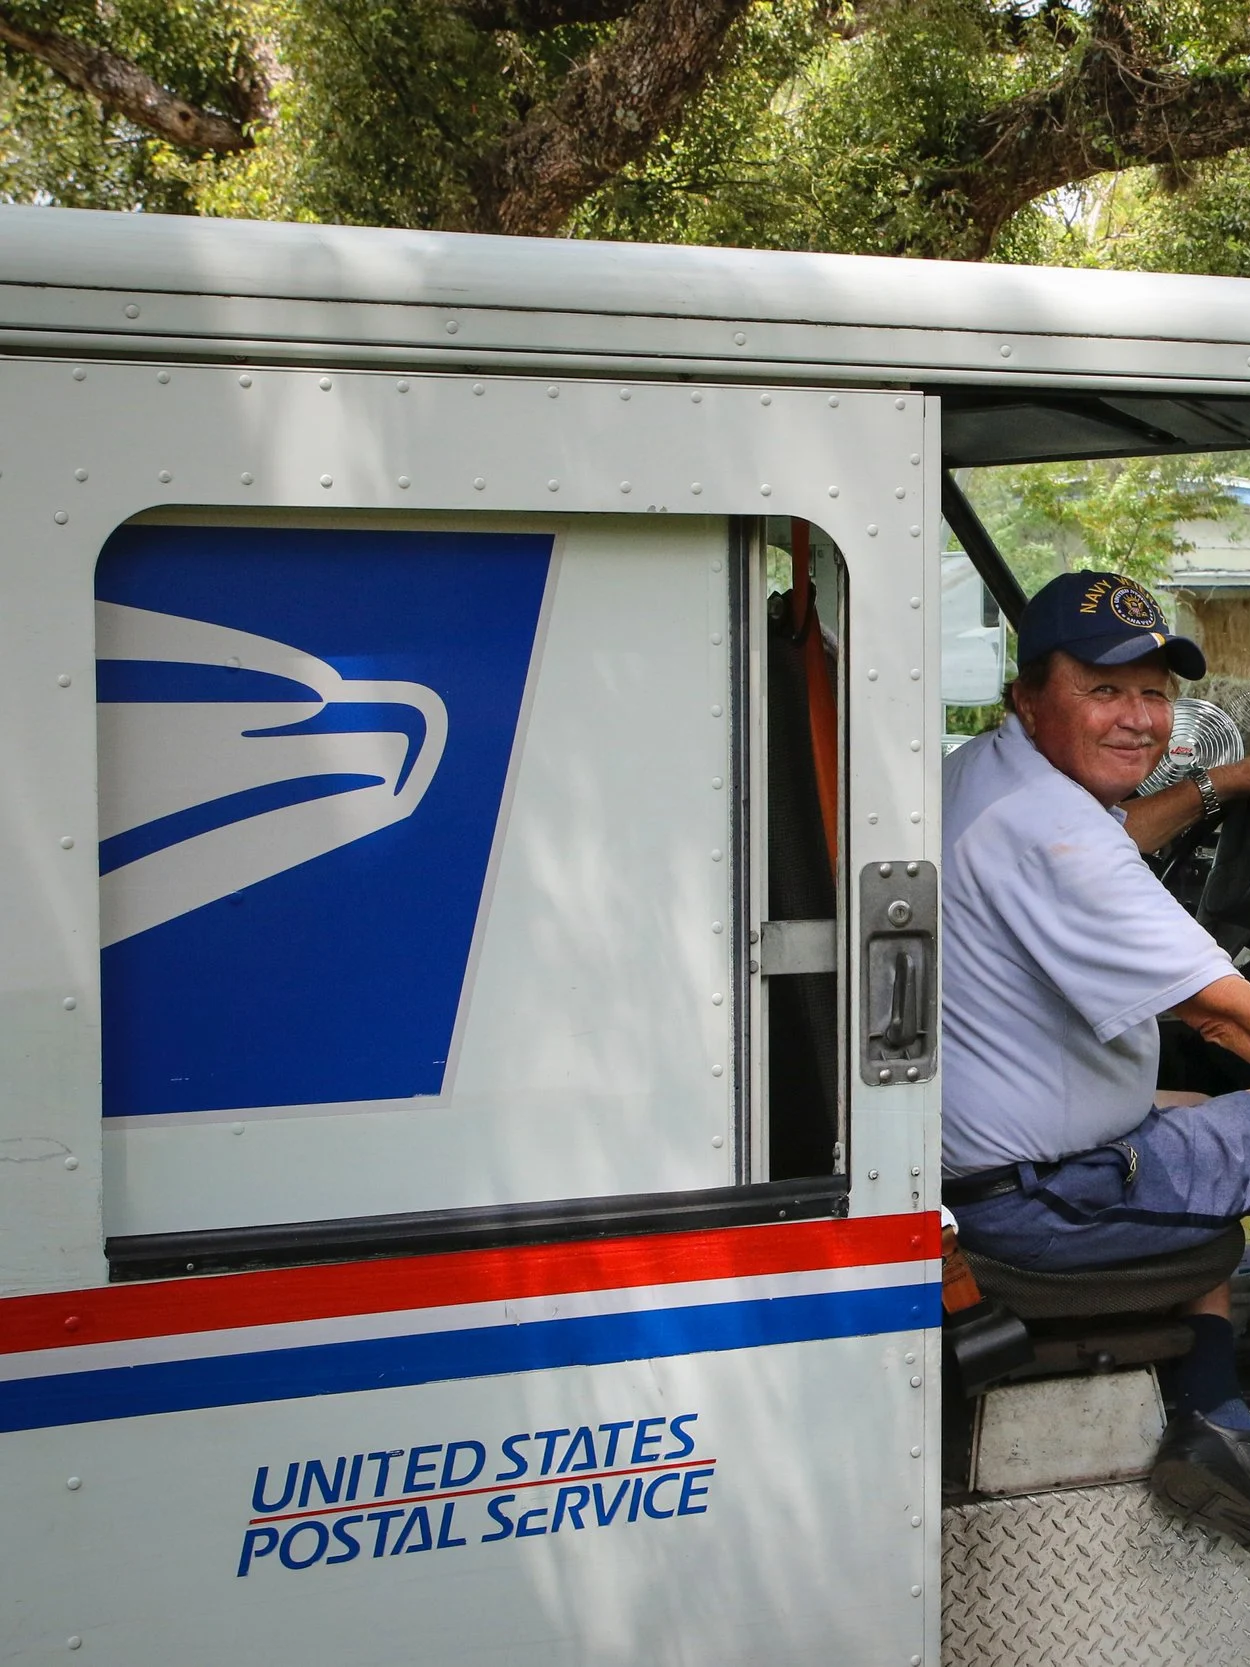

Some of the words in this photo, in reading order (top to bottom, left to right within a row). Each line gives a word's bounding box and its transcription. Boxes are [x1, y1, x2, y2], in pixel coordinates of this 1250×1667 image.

[1080, 580, 1112, 613] NAVY
[251, 1440, 487, 1513] UNITED
[496, 1413, 698, 1482] STATES
[236, 1502, 467, 1577] POSTAL
[481, 1468, 714, 1543] SERVICE
